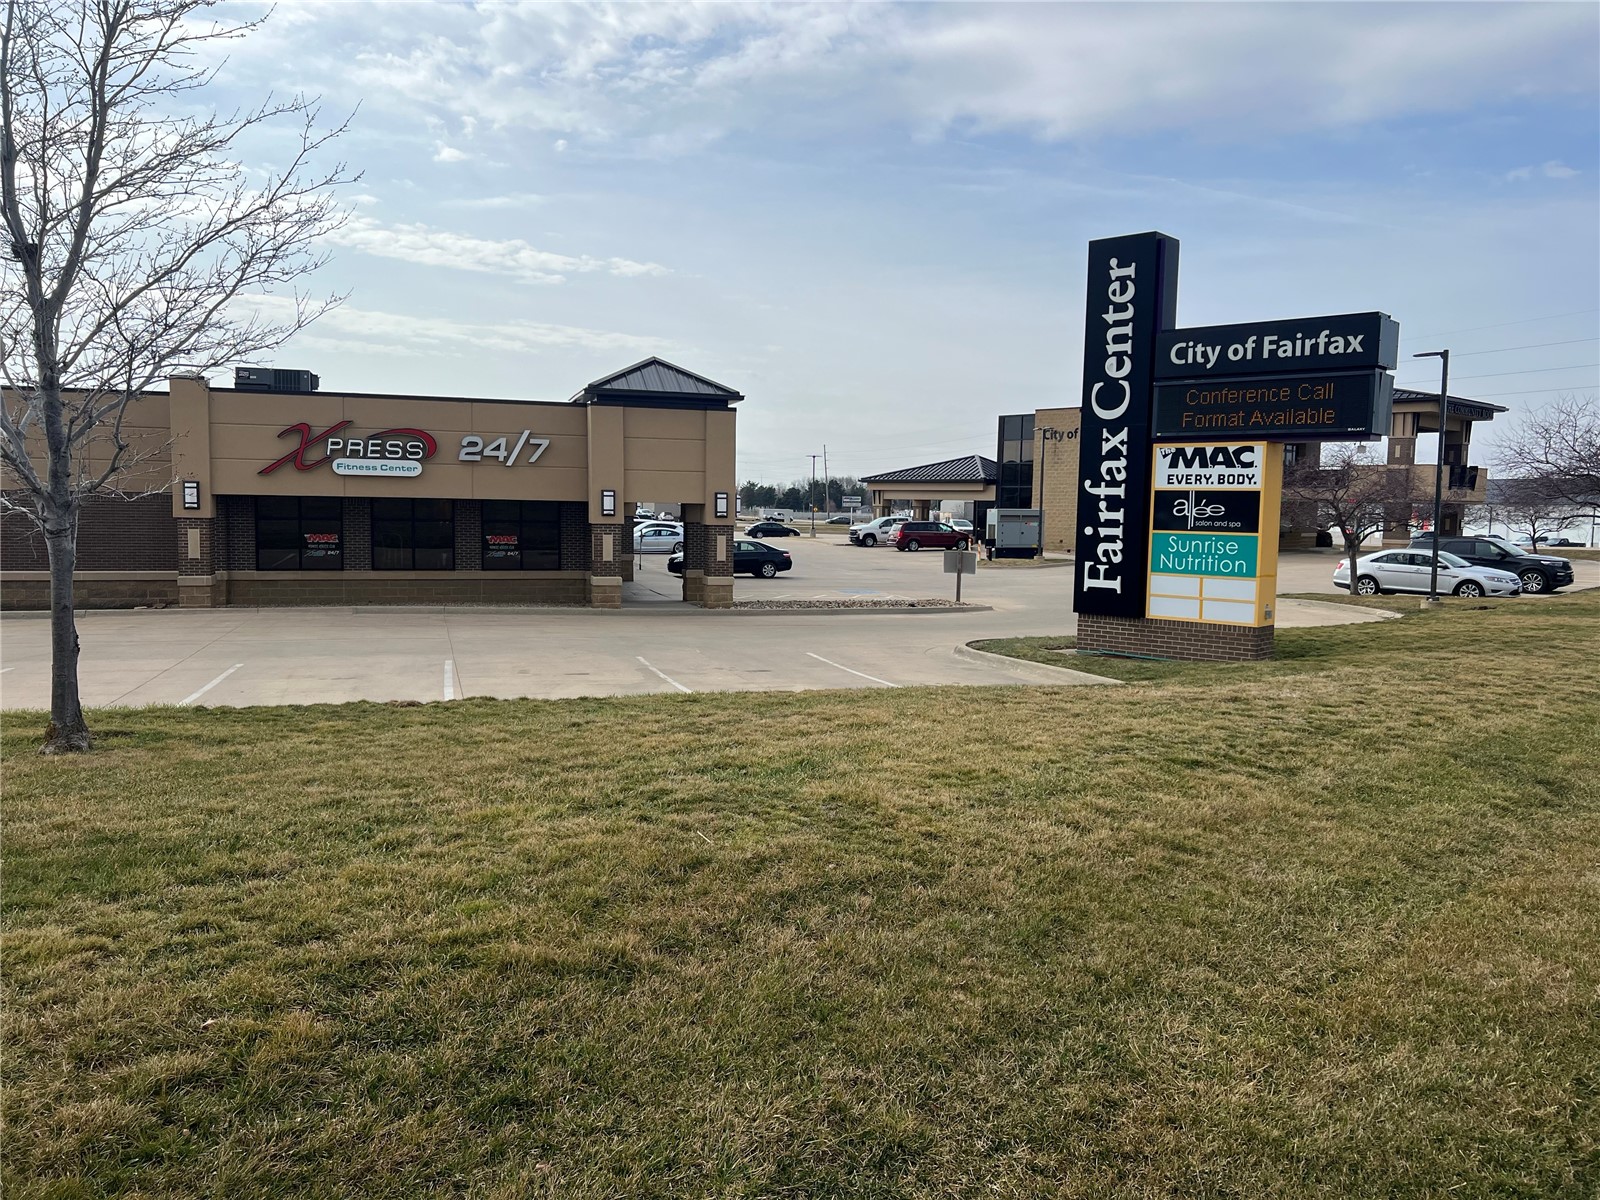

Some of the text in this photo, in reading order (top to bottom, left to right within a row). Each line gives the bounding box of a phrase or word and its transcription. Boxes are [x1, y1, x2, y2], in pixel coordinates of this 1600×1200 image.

[1170, 330, 1365, 369] City of Fairfax
[1186, 383, 1335, 405] Conference Call
[1084, 257, 1137, 594] Fairfax Center
[1182, 407, 1336, 428] Format Available
[1044, 427, 1079, 442] City of
[459, 430, 550, 467] 24/7
[1160, 447, 1176, 456] The
[336, 463, 419, 473] Fitness Center
[1167, 474, 1257, 485] EVERY. BODY.
[1168, 535, 1239, 555] Sunrise
[1160, 553, 1247, 573] Nutrition
